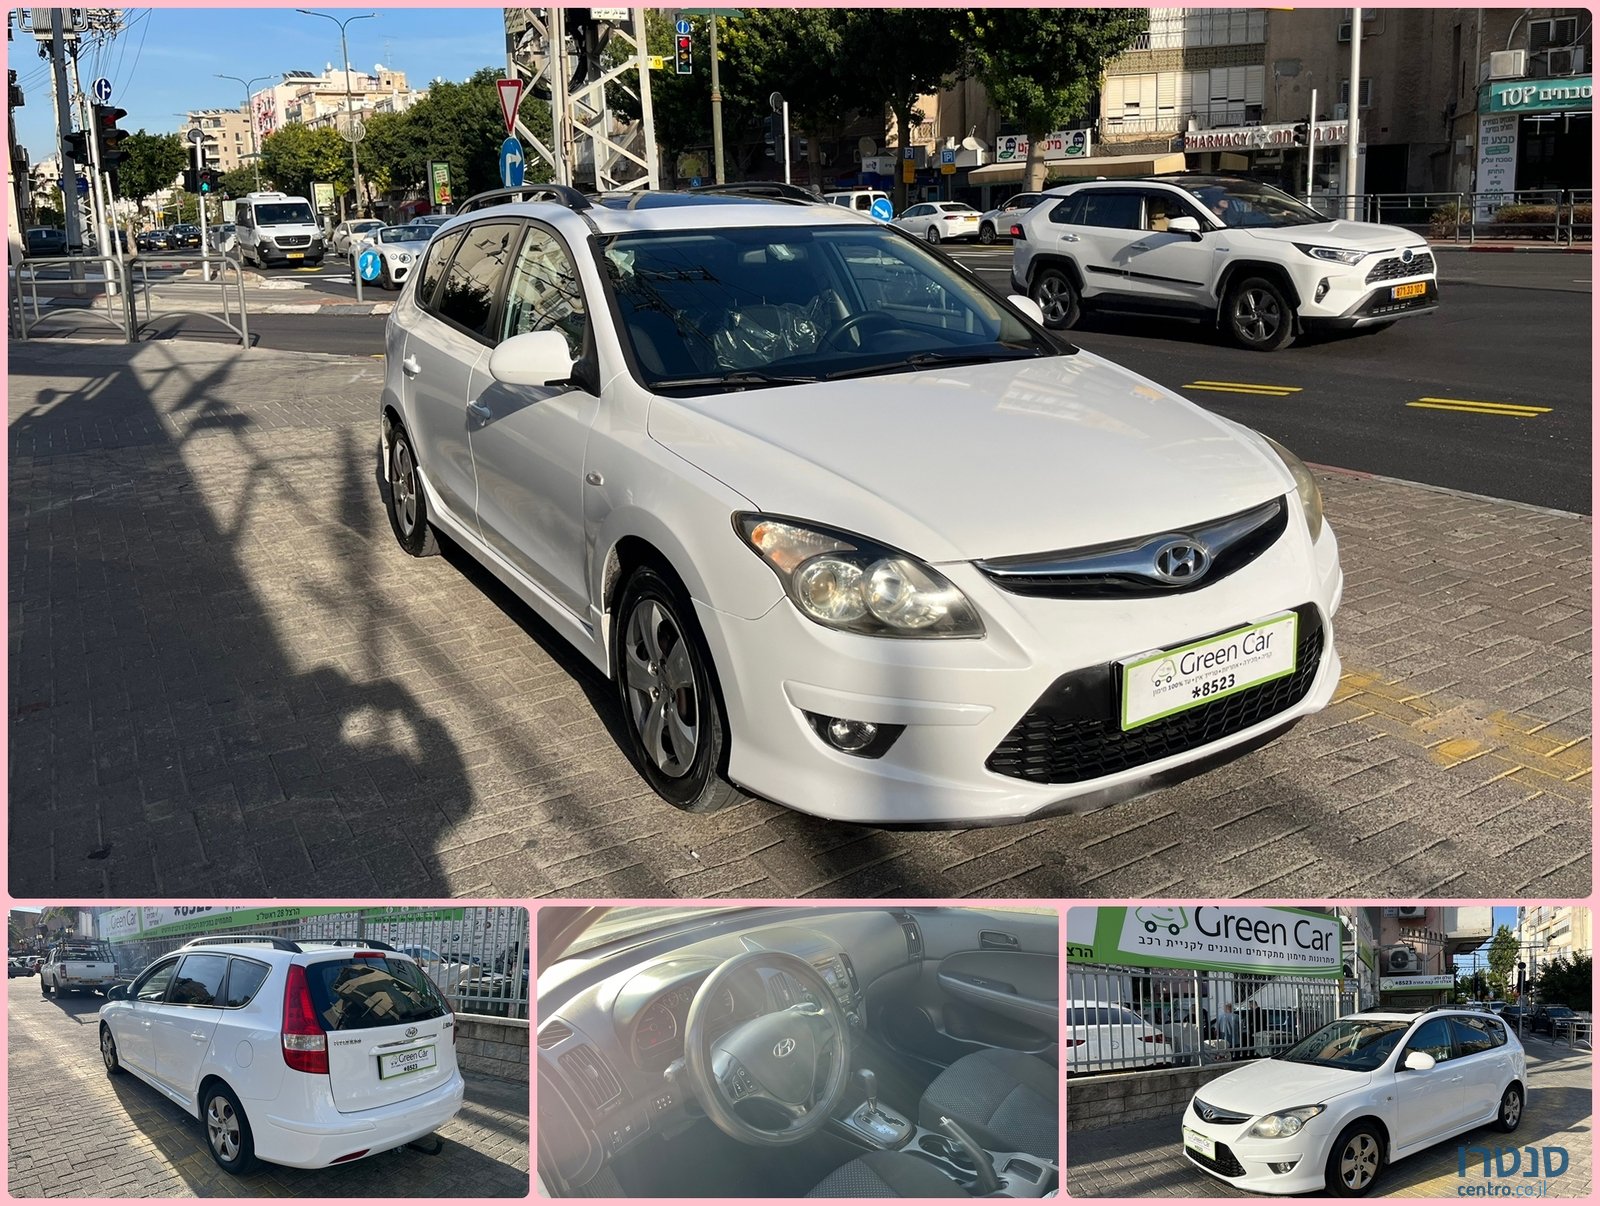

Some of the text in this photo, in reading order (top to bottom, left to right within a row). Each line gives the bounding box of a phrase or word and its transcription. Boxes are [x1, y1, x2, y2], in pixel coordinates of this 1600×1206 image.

[1499, 86, 1536, 106] TOP
[1185, 132, 1249, 149] PHARMACY
[1491, 136, 1515, 145] מבצע
[1180, 631, 1274, 676] Green Car
[1168, 681, 1184, 691] 100%
[127, 909, 137, 927] Car
[277, 909, 285, 918] 28
[286, 907, 301, 917] הרצל
[1195, 906, 1334, 952] Green Car
[1138, 936, 1335, 965] פתרונות מימון מתקדמים והוגנים לקניית רכב
[399, 1049, 428, 1063] Green Car
